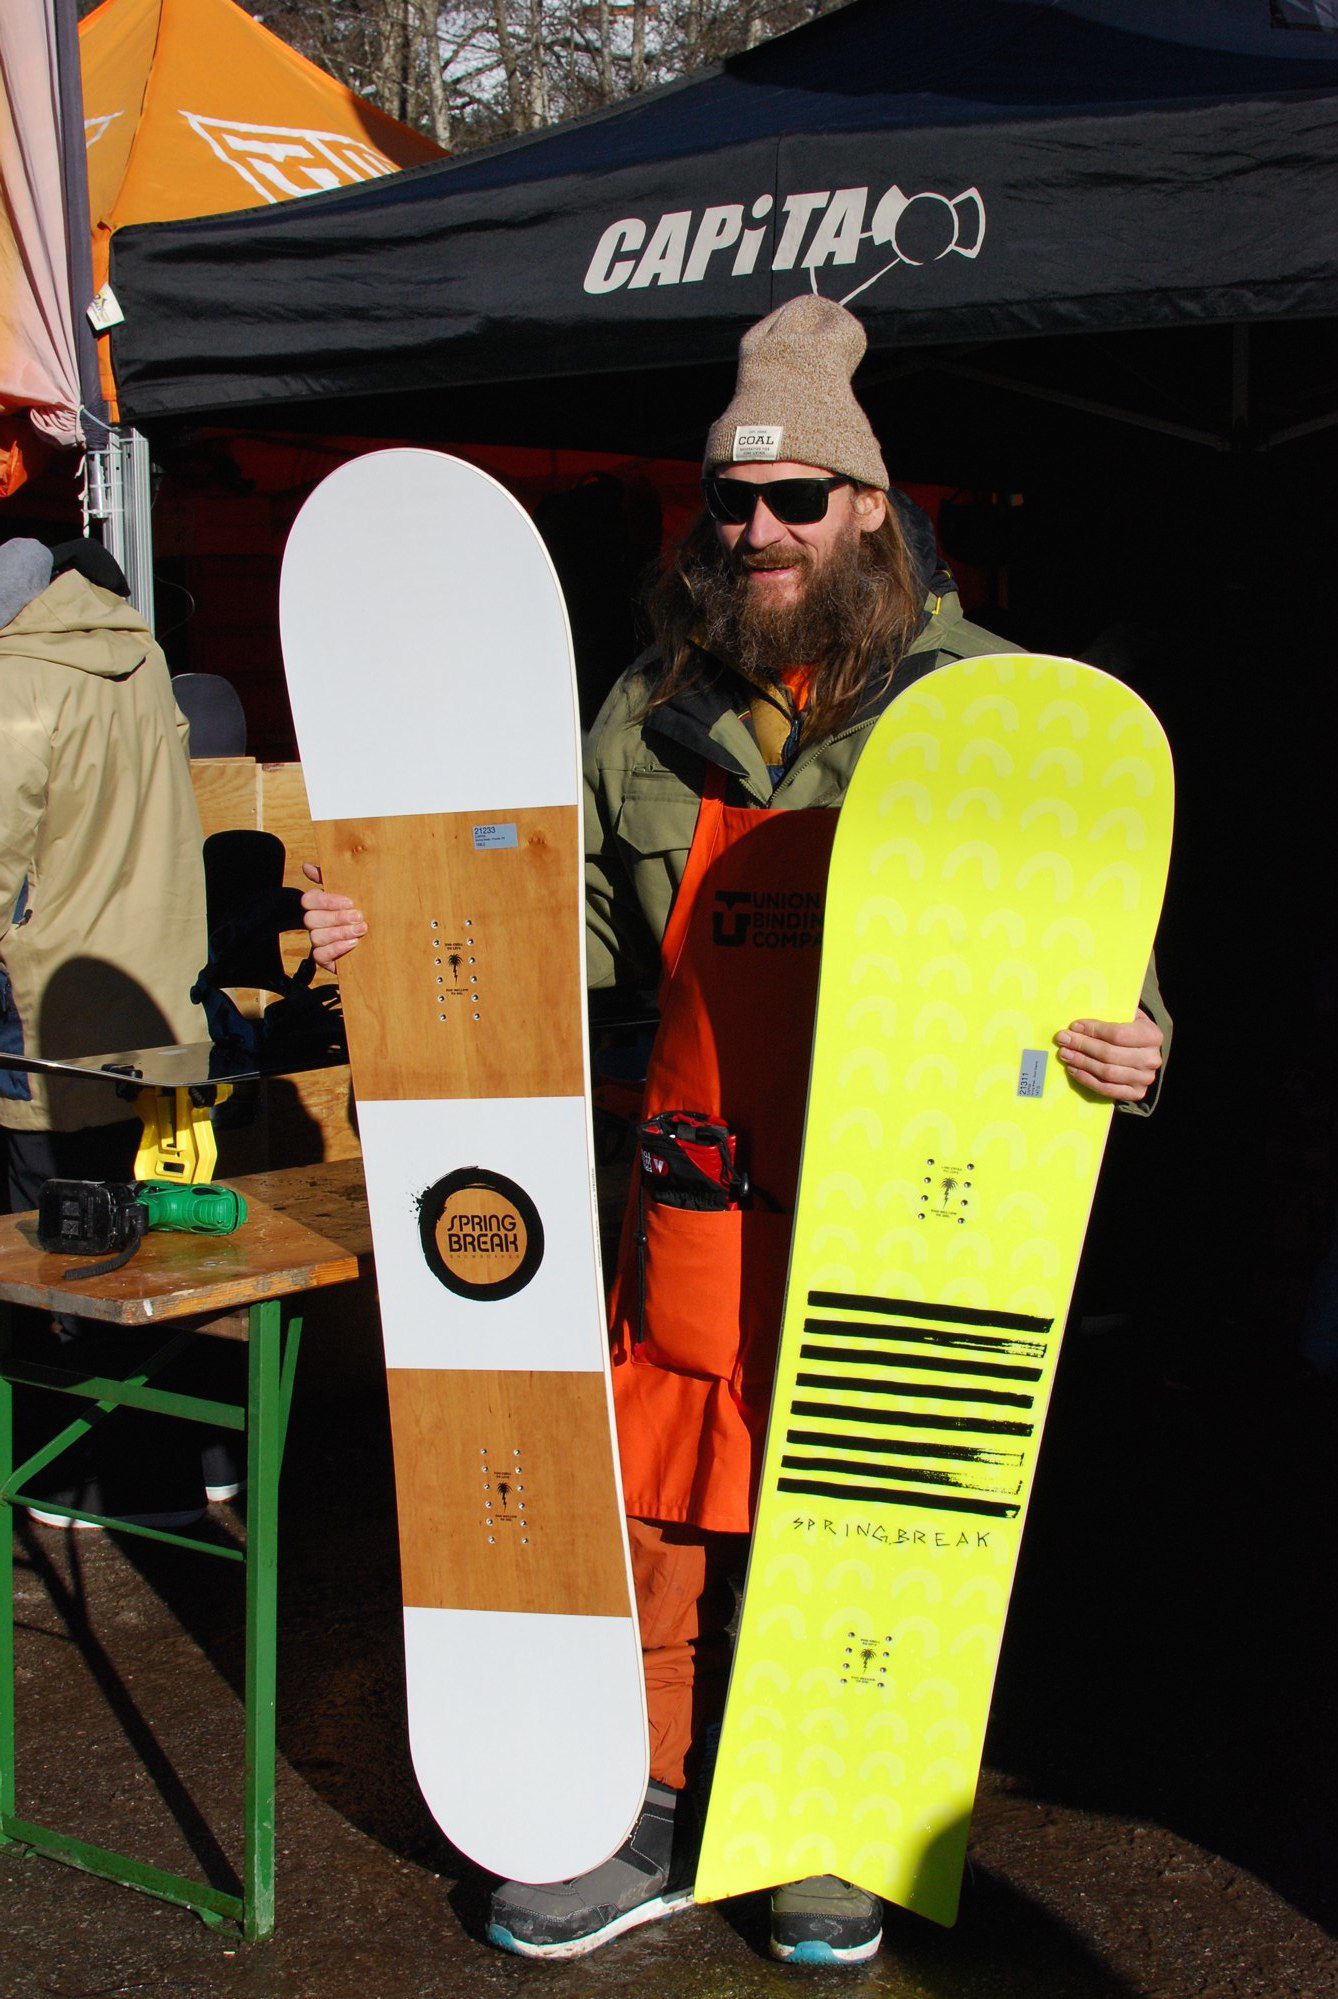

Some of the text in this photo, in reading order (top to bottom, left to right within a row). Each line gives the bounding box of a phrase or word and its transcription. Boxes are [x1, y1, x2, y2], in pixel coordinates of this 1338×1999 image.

[738, 435, 774, 446] COAL
[474, 826, 496, 835] 21233
[753, 892, 820, 909] UNION
[753, 912, 825, 929] BINDIN
[752, 931, 823, 948] COMPA
[447, 1214, 517, 1232] SPRING
[448, 1233, 518, 1252] BREAK
